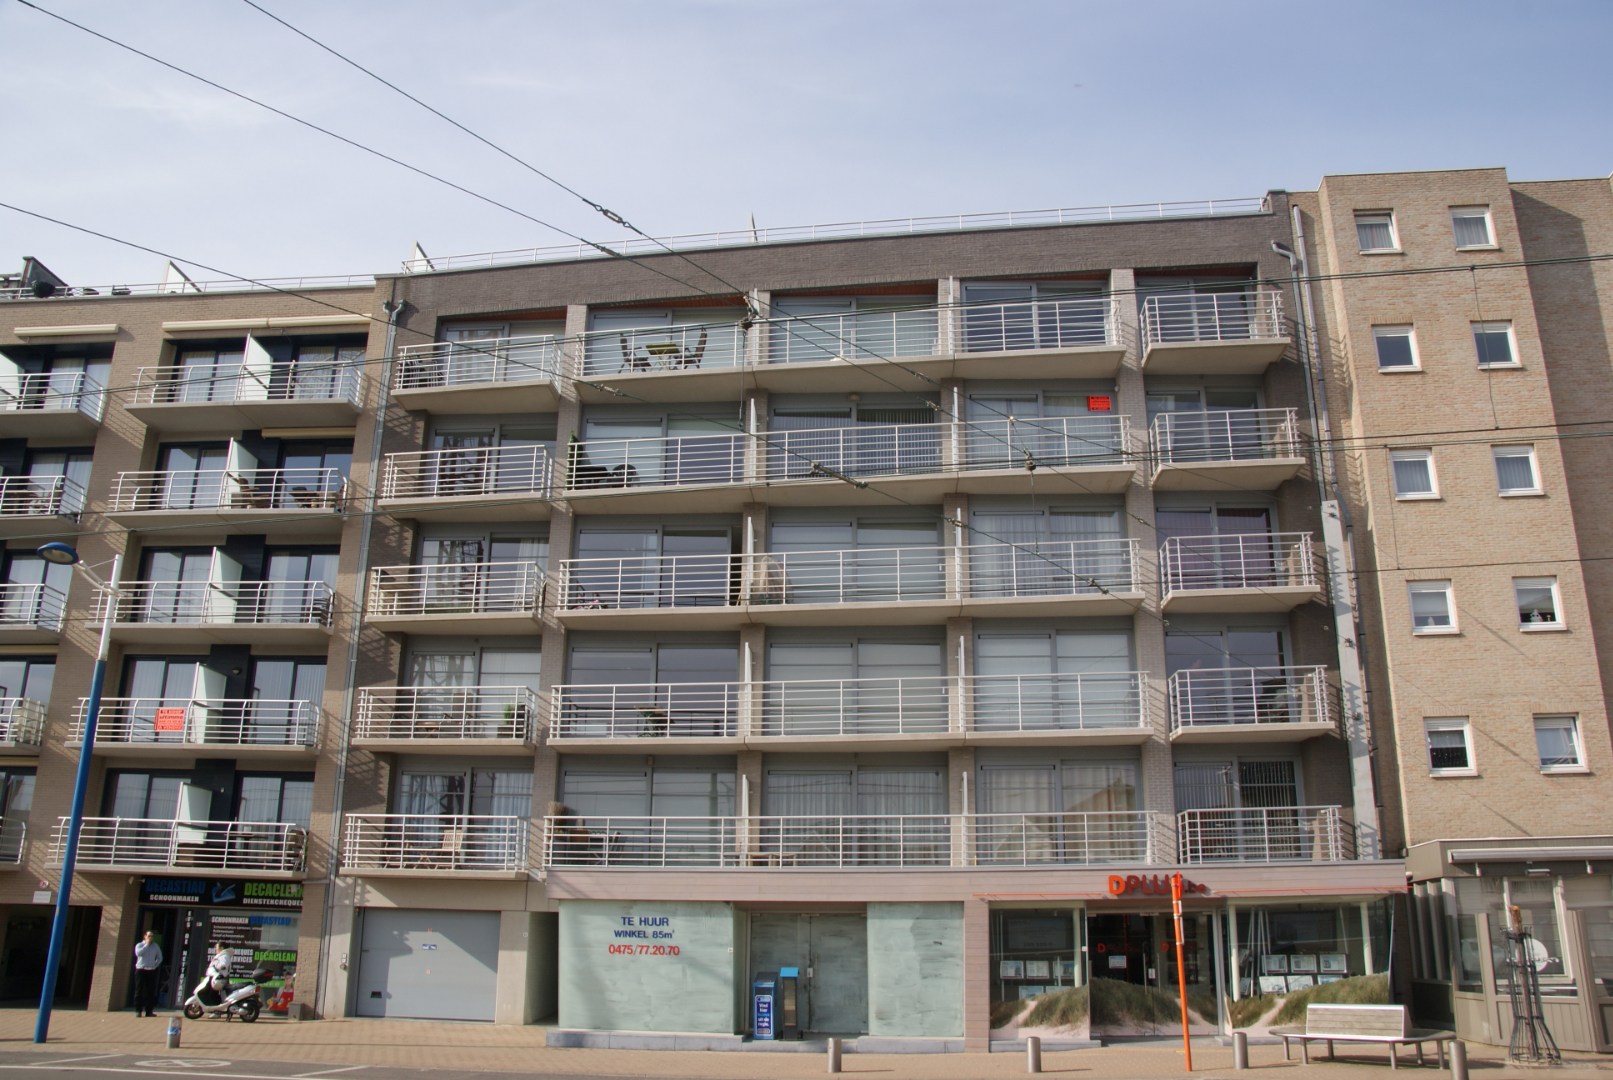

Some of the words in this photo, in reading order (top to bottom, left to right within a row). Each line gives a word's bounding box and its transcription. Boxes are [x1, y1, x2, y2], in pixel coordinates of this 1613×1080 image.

[149, 894, 200, 903] SCHOONMAKEN
[621, 916, 635, 926] TE
[639, 917, 669, 927] HUUR
[614, 930, 649, 938] WINKEL
[608, 944, 680, 956] 0475/77.20.70
[254, 950, 297, 962] DECACLEAN
